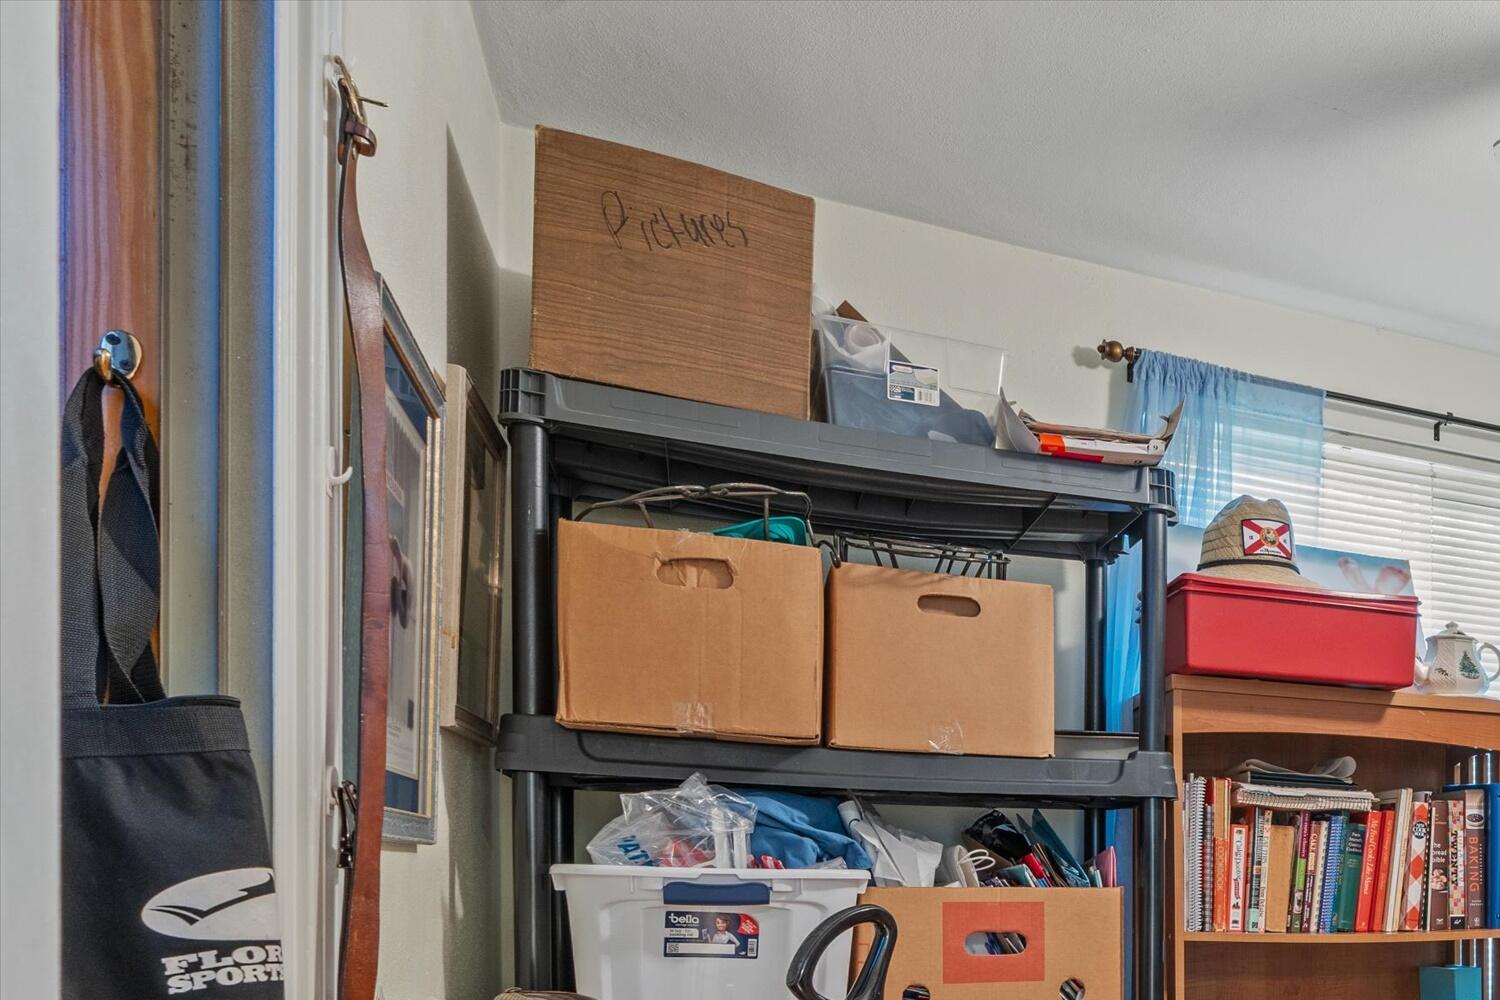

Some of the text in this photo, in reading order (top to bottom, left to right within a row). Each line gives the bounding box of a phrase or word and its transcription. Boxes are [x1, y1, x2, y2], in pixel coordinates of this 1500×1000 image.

[600, 190, 749, 251] Pictures
[1450, 830, 1458, 886] TWENTY
[1469, 836, 1479, 892] BAKING
[668, 912, 700, 924] bella
[166, 963, 285, 995] SPORT
